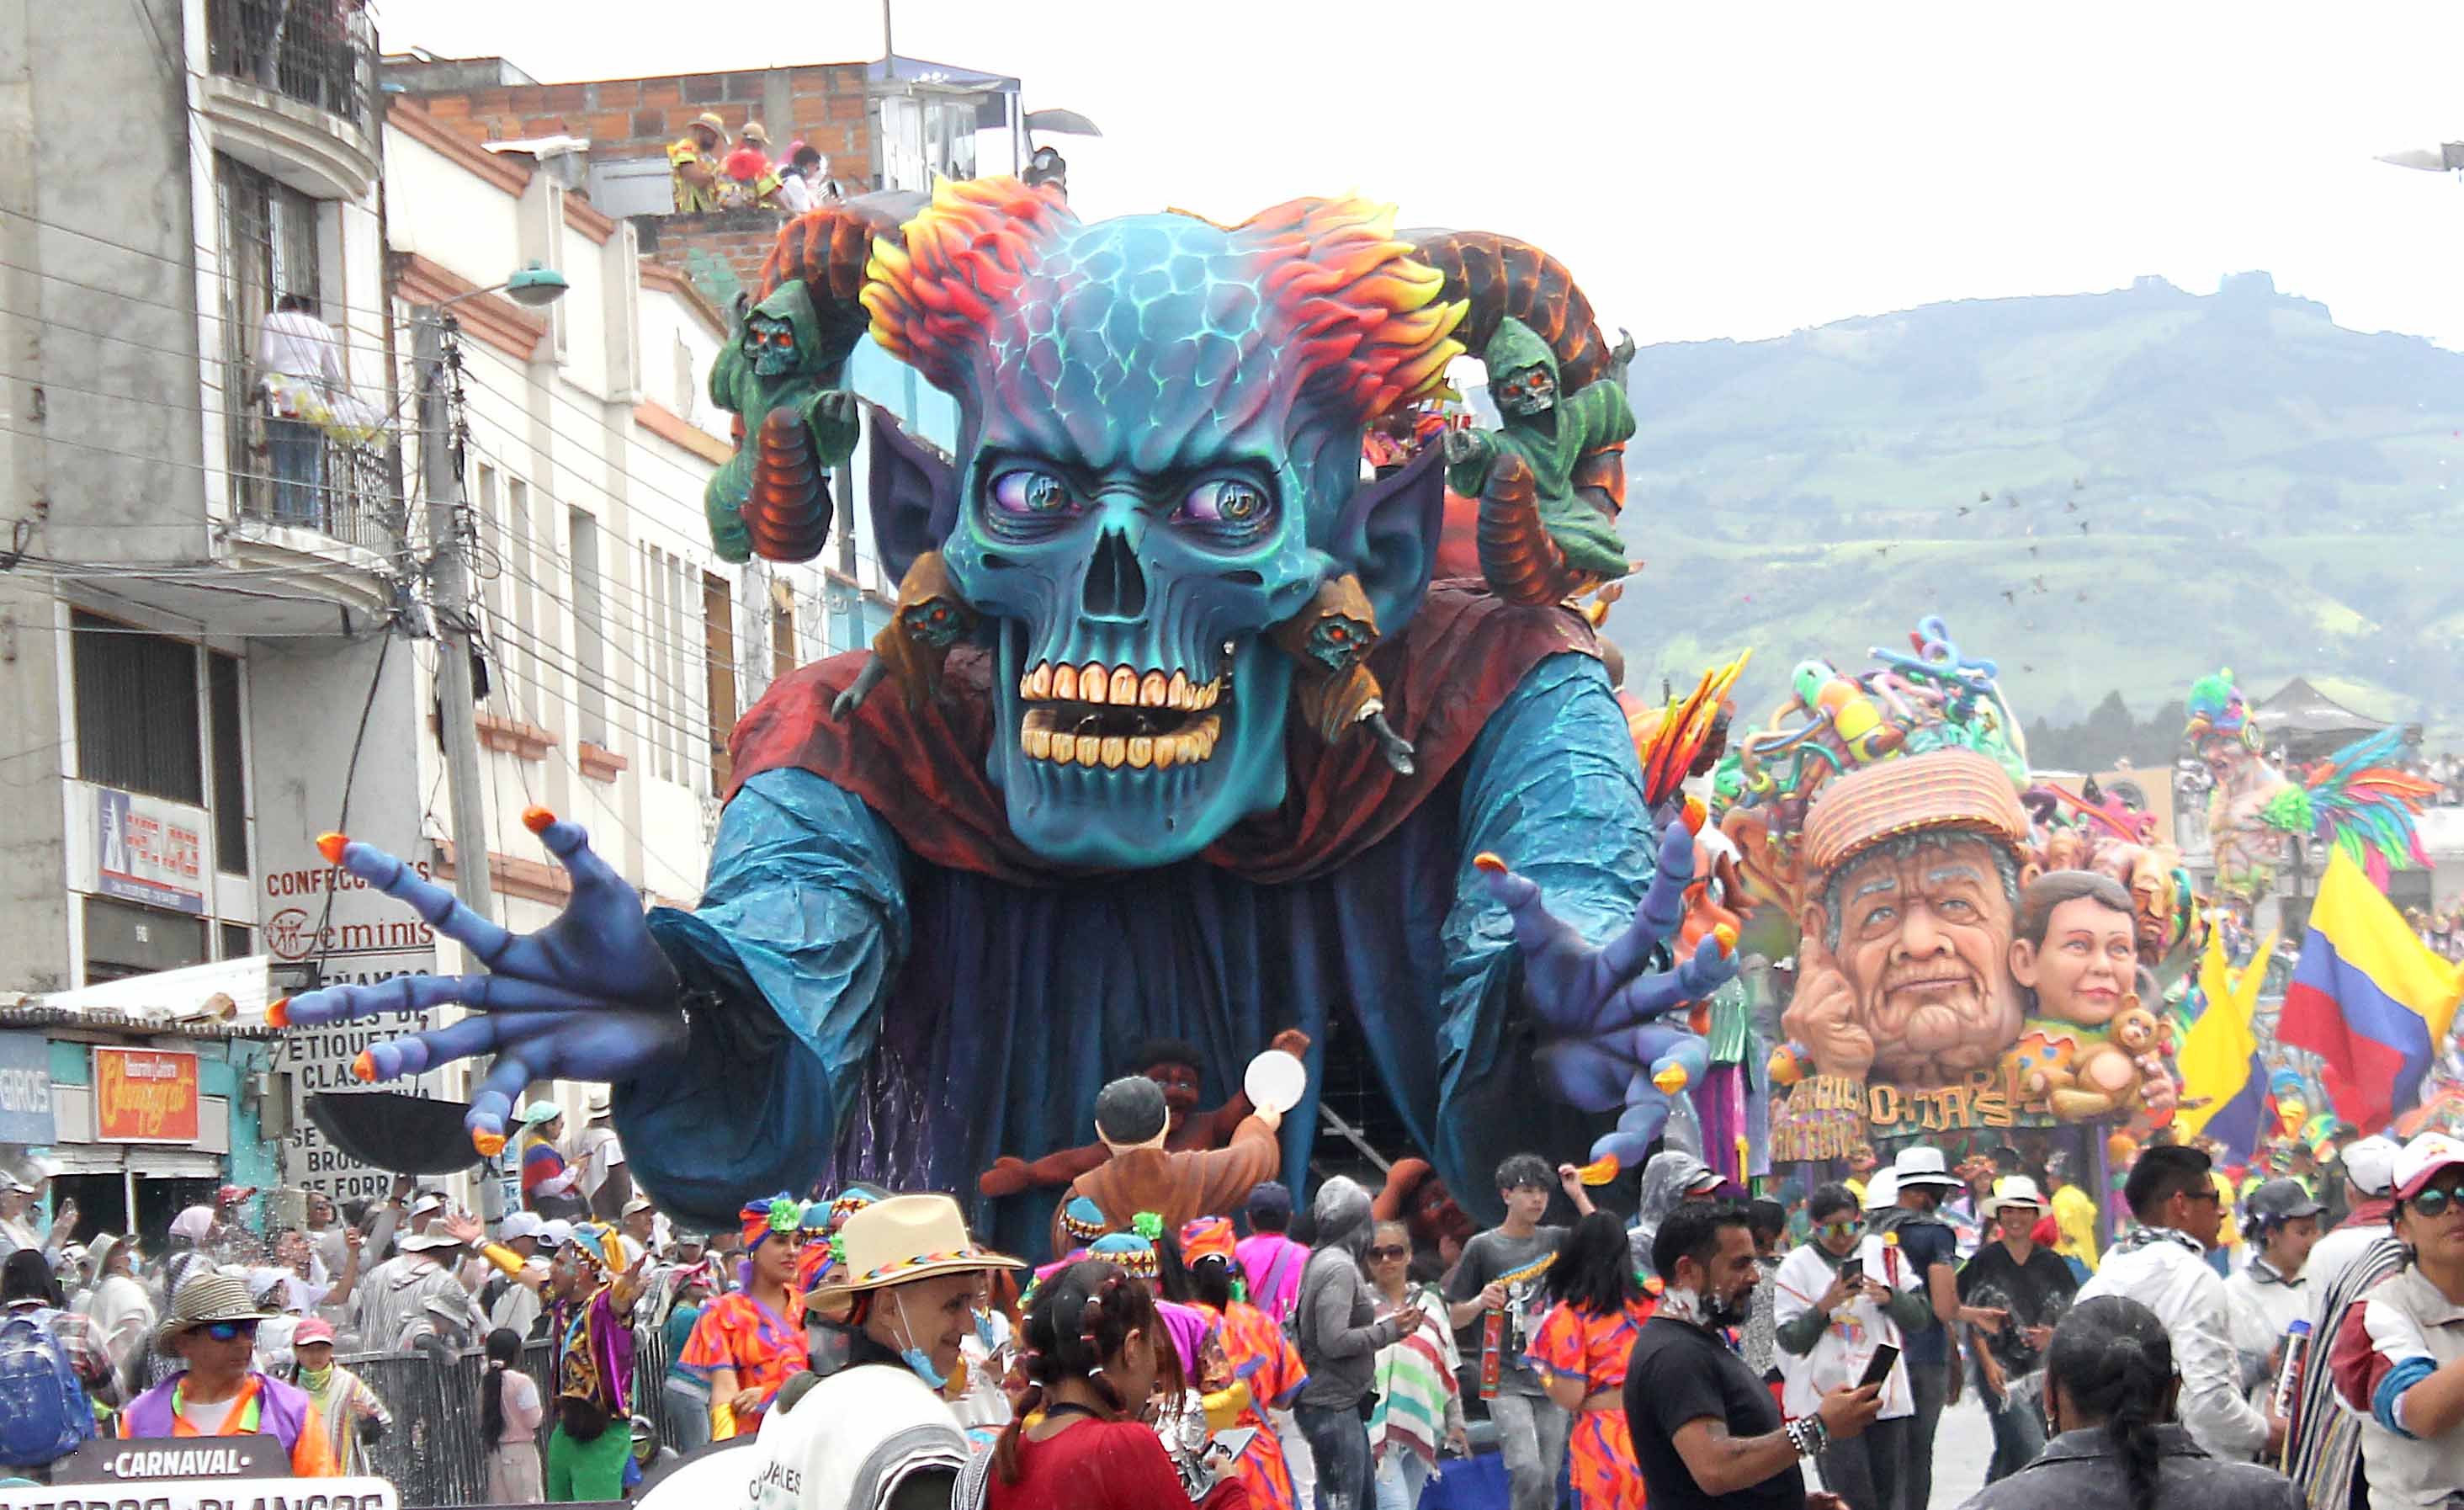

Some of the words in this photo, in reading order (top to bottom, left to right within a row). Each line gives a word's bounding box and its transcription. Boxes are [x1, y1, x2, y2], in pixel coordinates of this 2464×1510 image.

[267, 860, 432, 897] CONFECCS
[289, 1029, 411, 1062] ETIQUET
[114, 1449, 240, 1479] CARNAVAL
